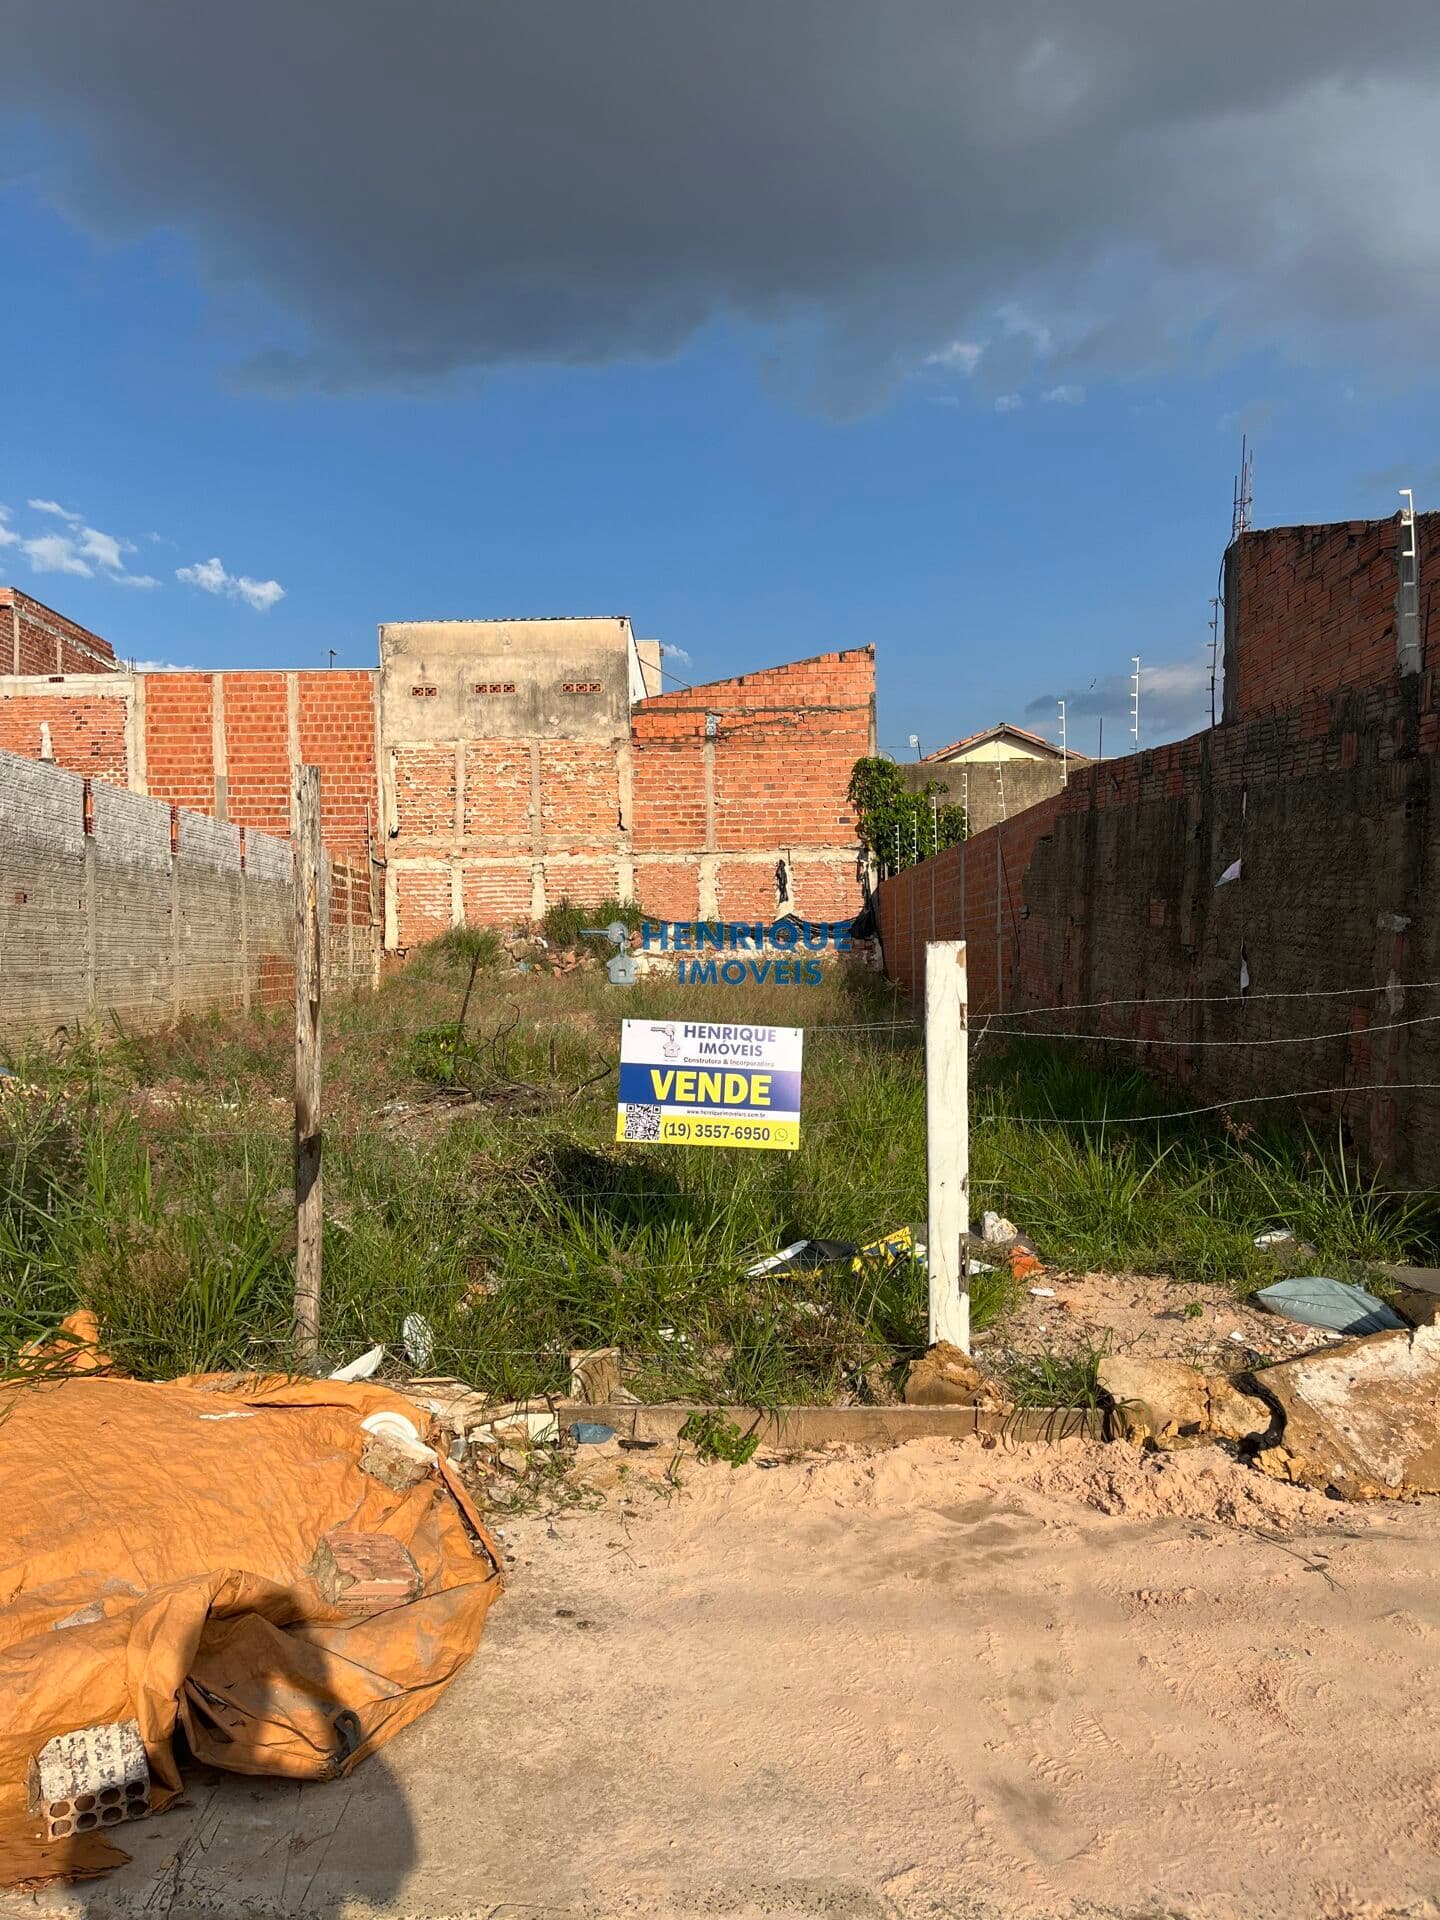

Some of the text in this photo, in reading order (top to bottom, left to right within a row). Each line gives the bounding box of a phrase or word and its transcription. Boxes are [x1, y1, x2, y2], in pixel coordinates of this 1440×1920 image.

[684, 1025, 776, 1043] HENRIQUE
[699, 1040, 763, 1057] IMÓVEIS
[683, 1056, 722, 1065] Construtora
[730, 1059, 775, 1068] Incorporadora
[650, 1069, 772, 1106] VENDE
[663, 1122, 771, 1142] (19) 3557-6950
